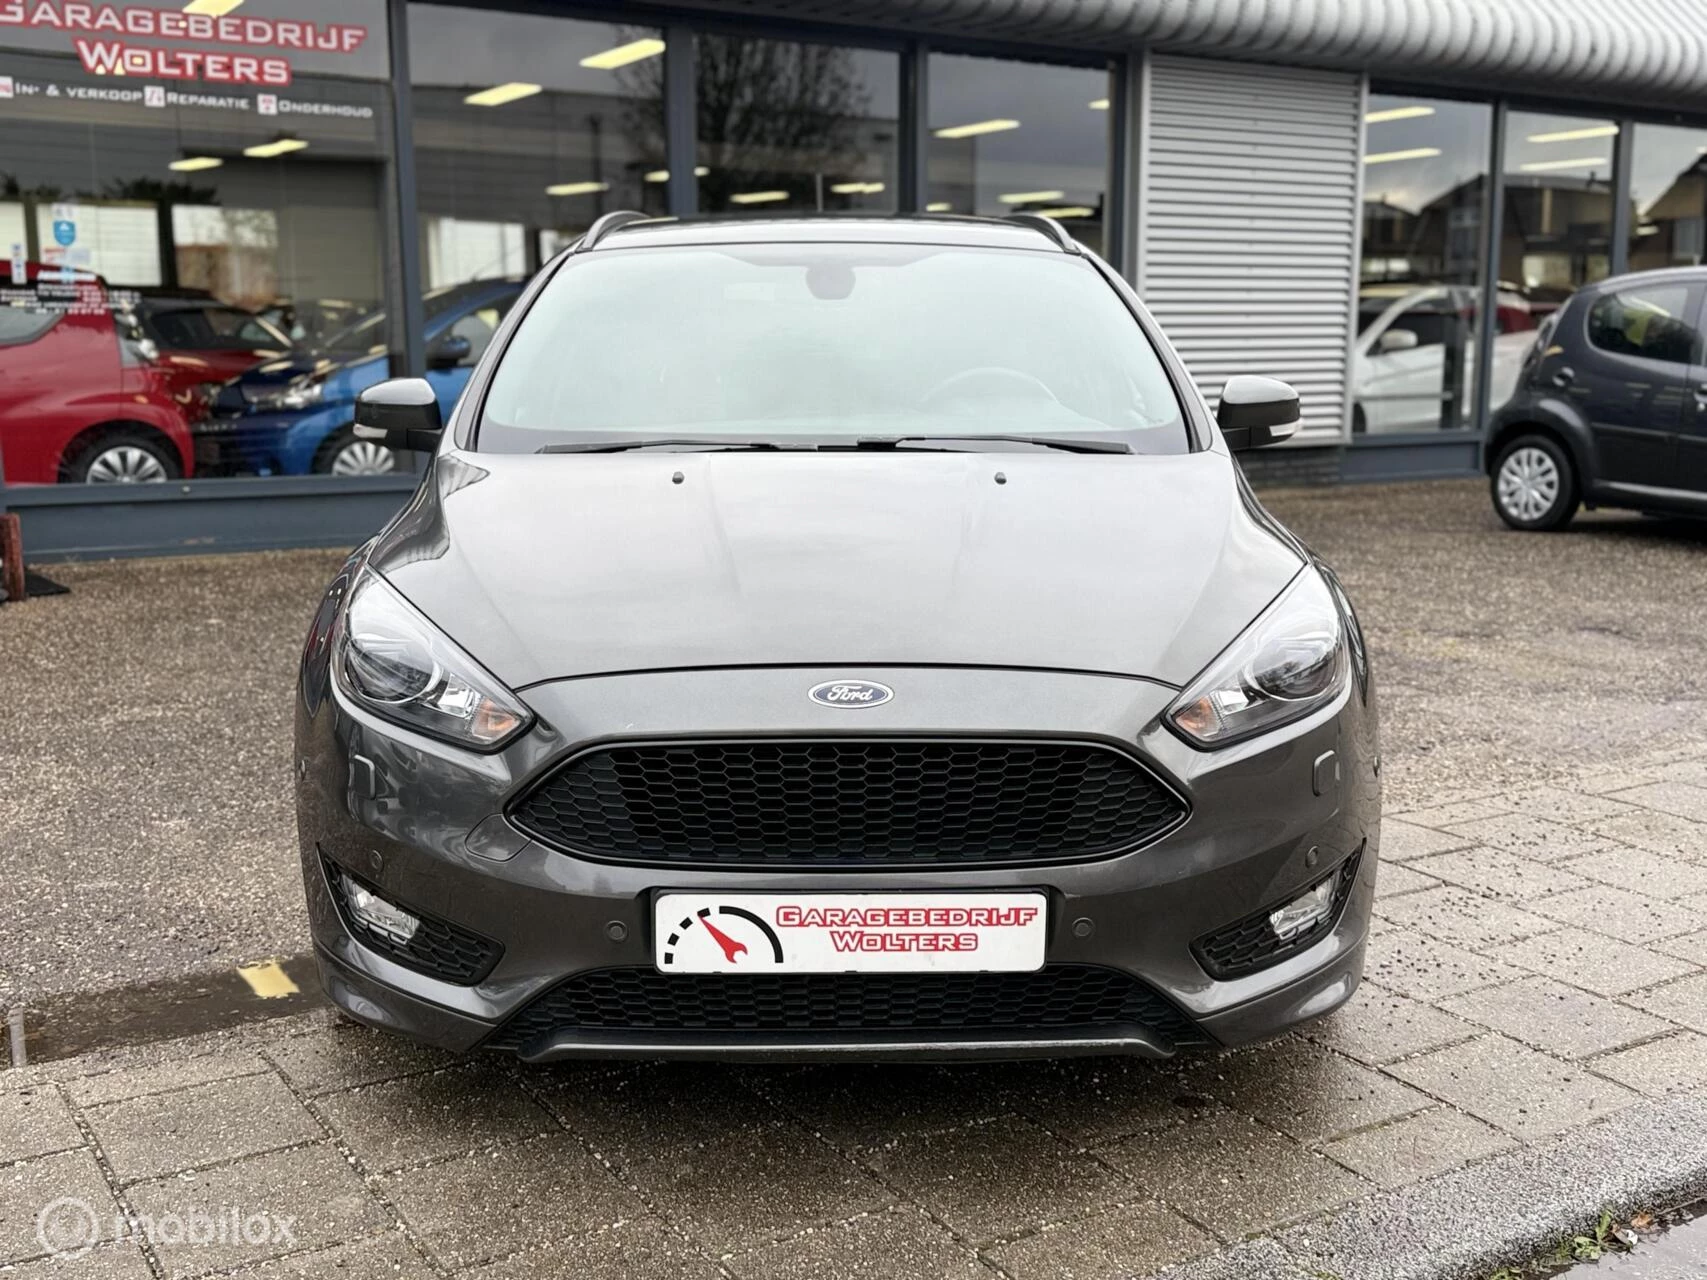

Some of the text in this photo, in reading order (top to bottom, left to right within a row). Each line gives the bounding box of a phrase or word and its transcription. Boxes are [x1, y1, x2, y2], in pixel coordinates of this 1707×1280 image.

[74, 38, 291, 85] WOLTERS
[46, 84, 60, 97] &
[166, 92, 250, 109] REPARATIE
[278, 100, 373, 118] ONDERHOUD
[827, 685, 874, 701] Ford
[776, 906, 1038, 927] GARAGEBEDRIJF
[830, 931, 979, 952] WOLTERS
